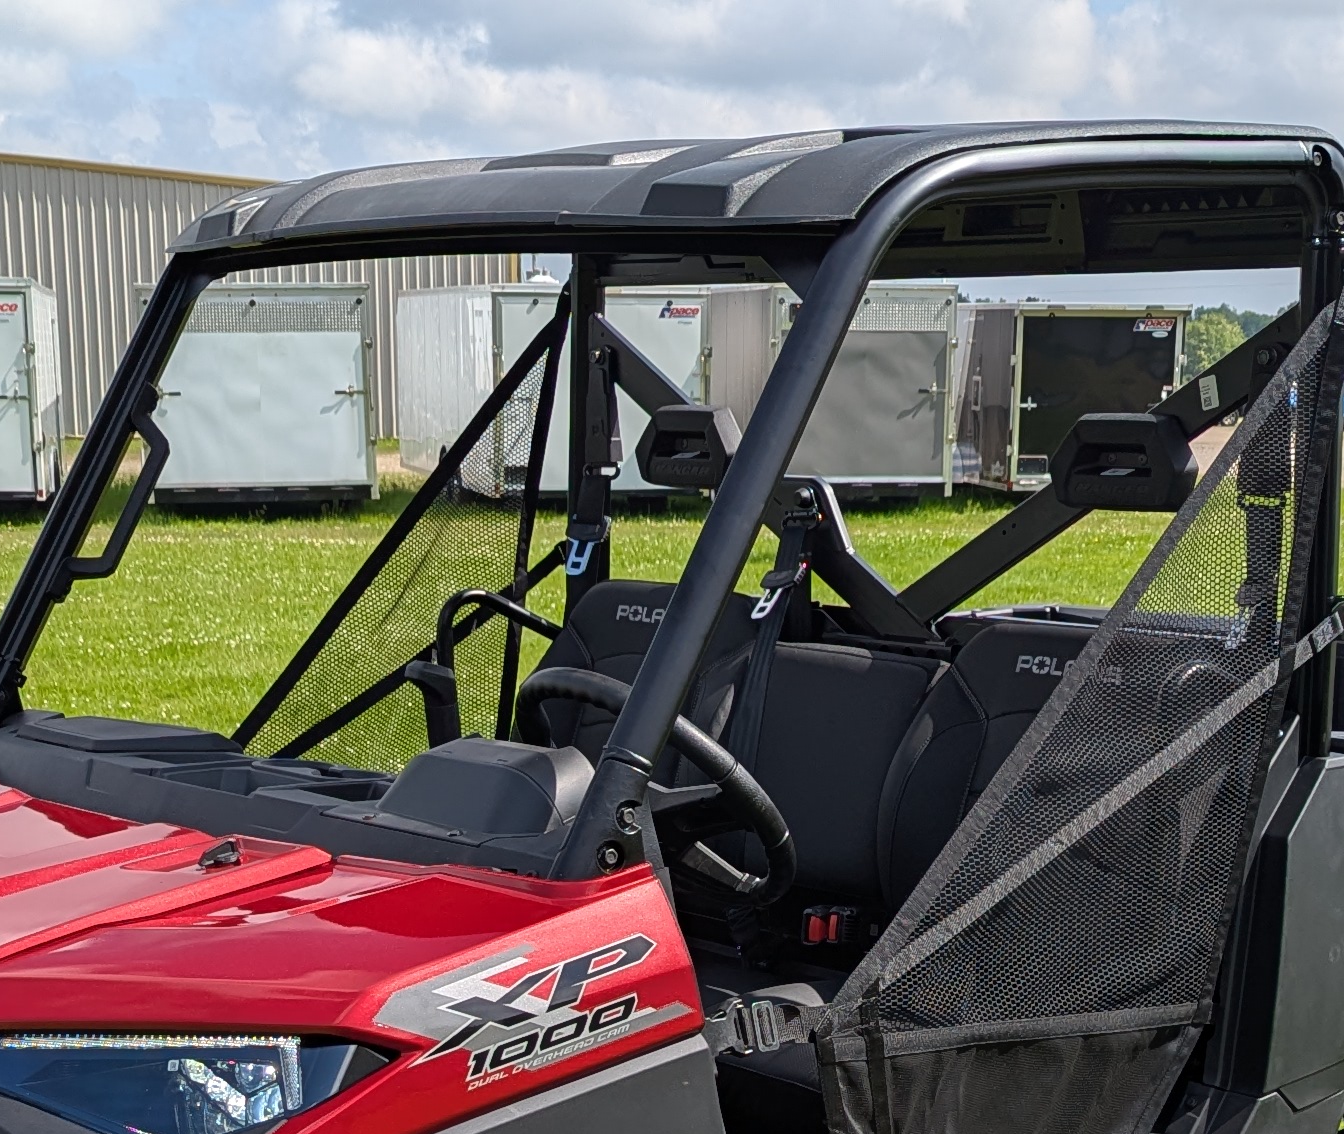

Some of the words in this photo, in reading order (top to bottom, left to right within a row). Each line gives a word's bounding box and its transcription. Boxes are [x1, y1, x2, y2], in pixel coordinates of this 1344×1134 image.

[616, 604, 666, 624] POLA
[407, 932, 658, 1069] XP
[465, 992, 638, 1083] 1000
[467, 1070, 509, 1091] DUAL
[512, 1037, 594, 1074] OVERHEAD
[596, 1023, 631, 1043] CAM
